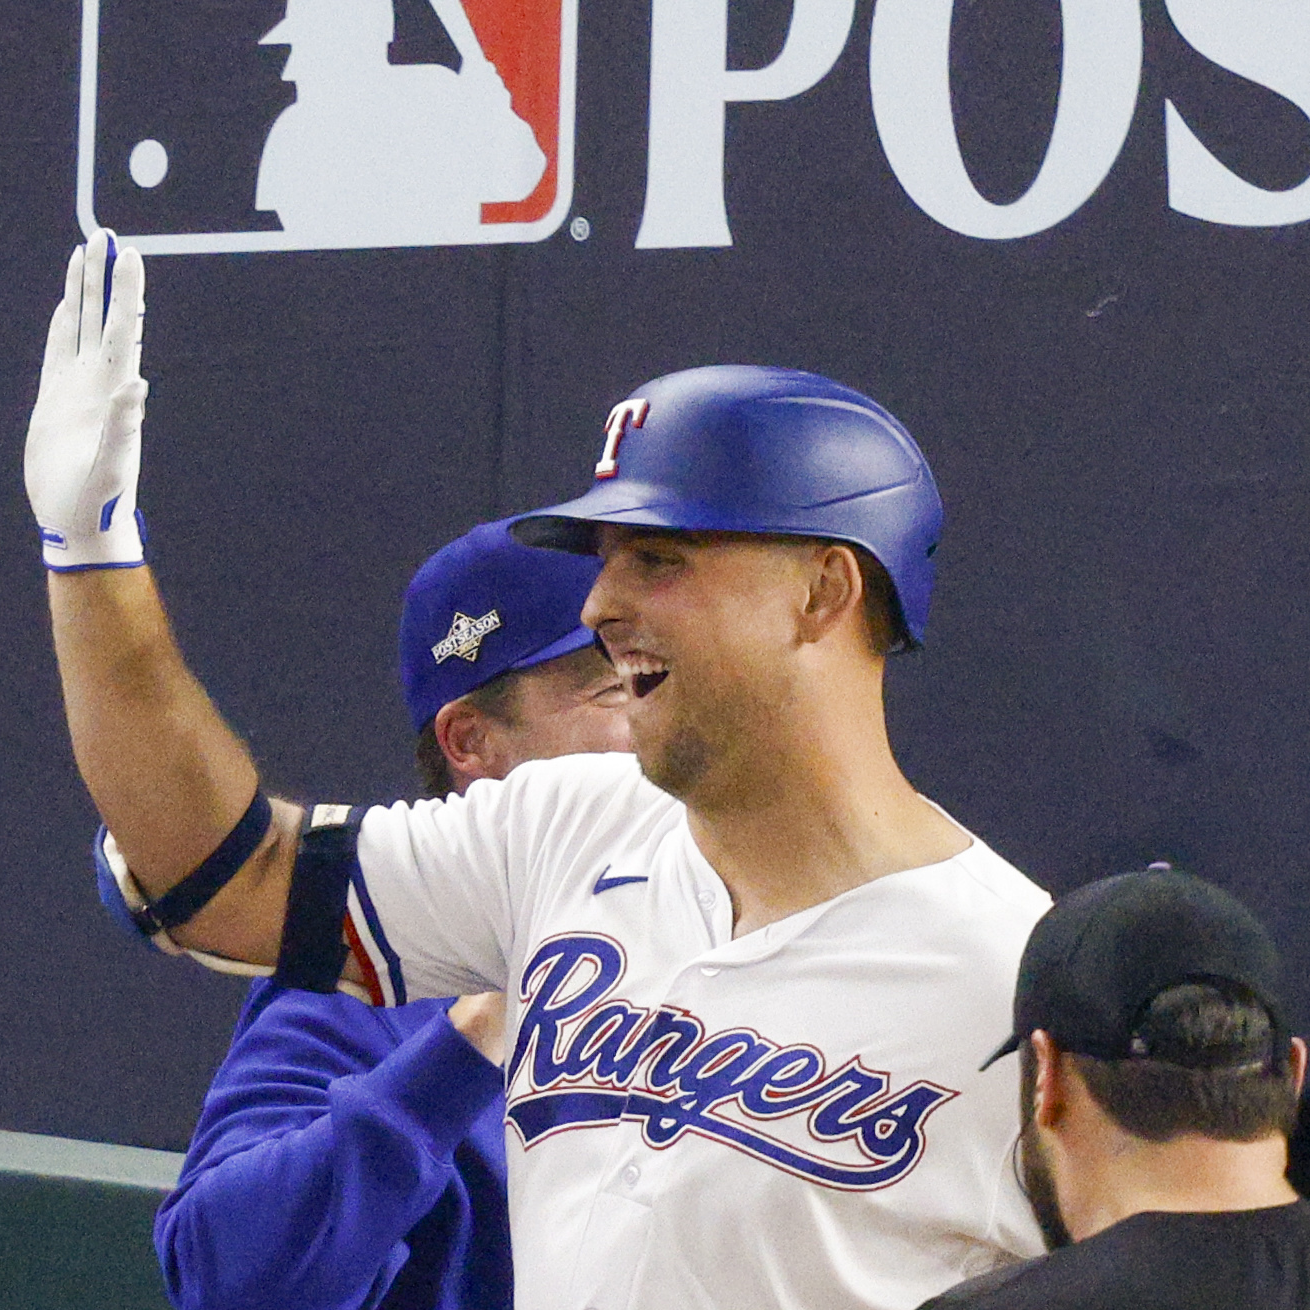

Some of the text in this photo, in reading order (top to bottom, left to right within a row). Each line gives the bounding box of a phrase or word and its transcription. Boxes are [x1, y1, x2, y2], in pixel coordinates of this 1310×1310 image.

[594, 397, 649, 479] T
[432, 613, 500, 662] POSTSEASON
[506, 931, 961, 1192] Rangers
